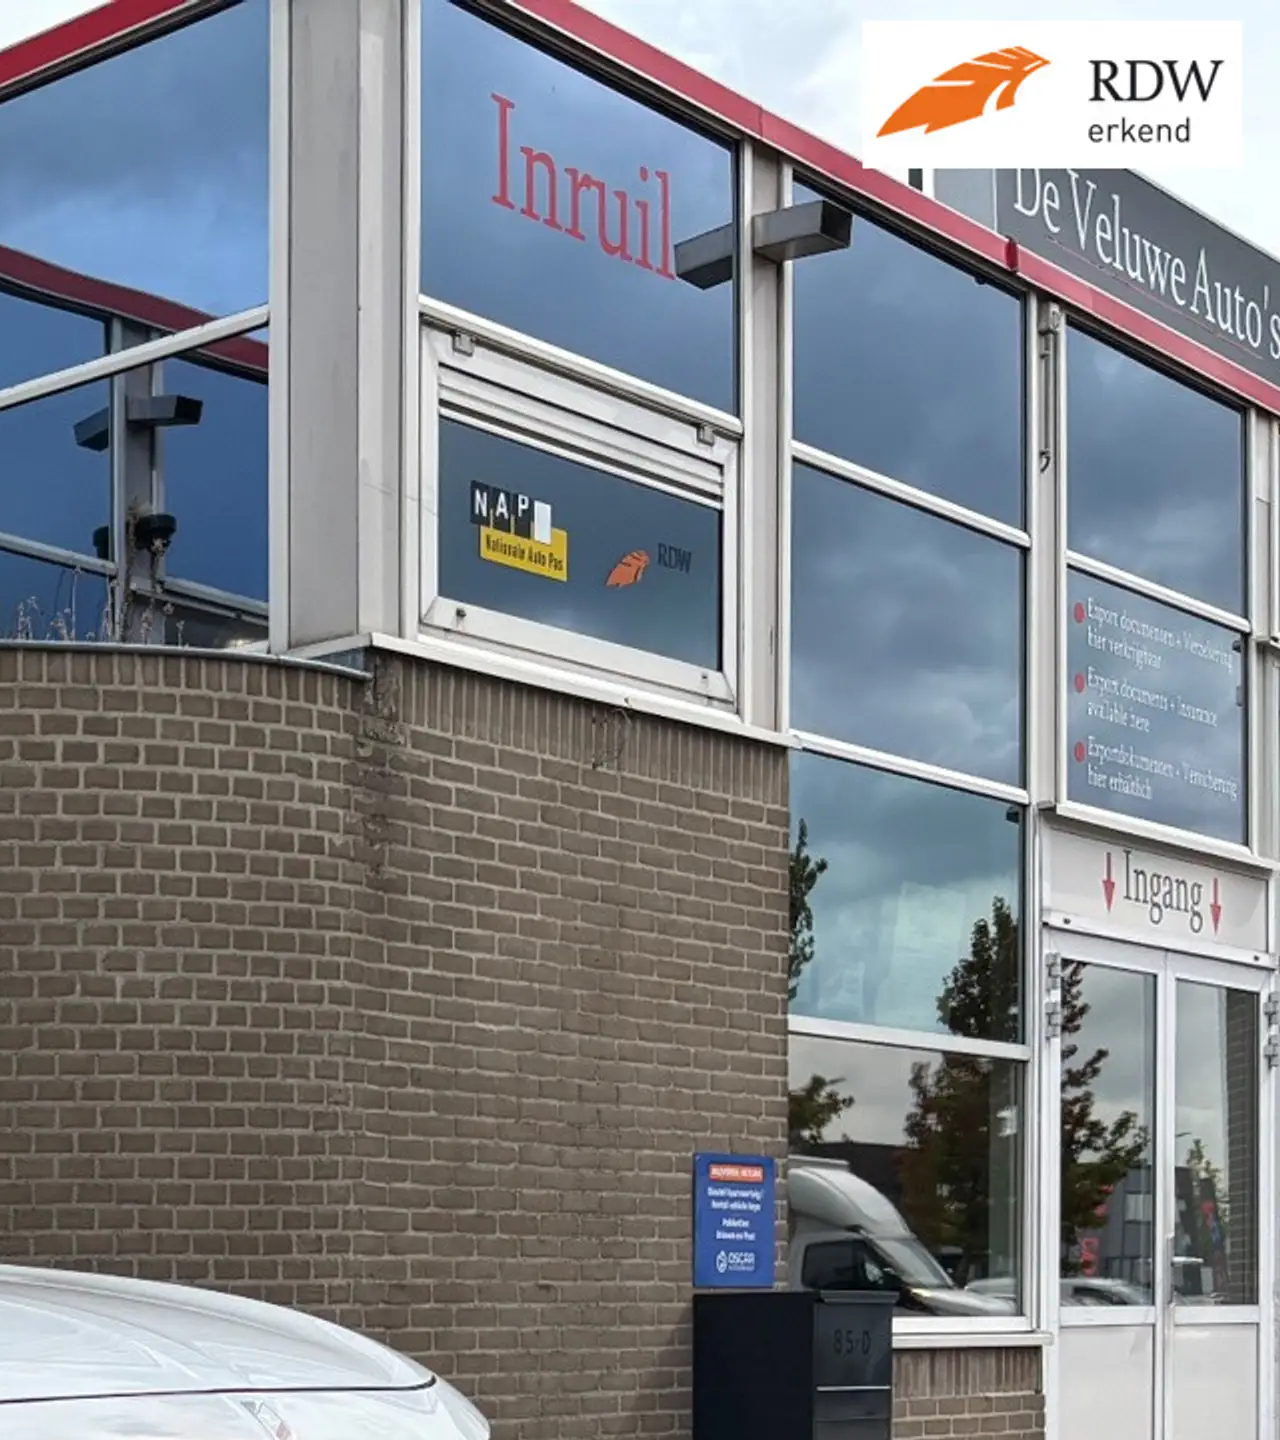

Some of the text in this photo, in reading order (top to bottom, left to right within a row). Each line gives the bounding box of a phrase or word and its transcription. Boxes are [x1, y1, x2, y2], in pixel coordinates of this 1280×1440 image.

[490, 92, 676, 281] Inruil
[1013, 168, 1280, 360] De Veluwe Auto's
[474, 488, 530, 520] NAP
[527, 545, 547, 567] Auto
[657, 542, 692, 574] RDW
[1122, 848, 1204, 934] Ingang
